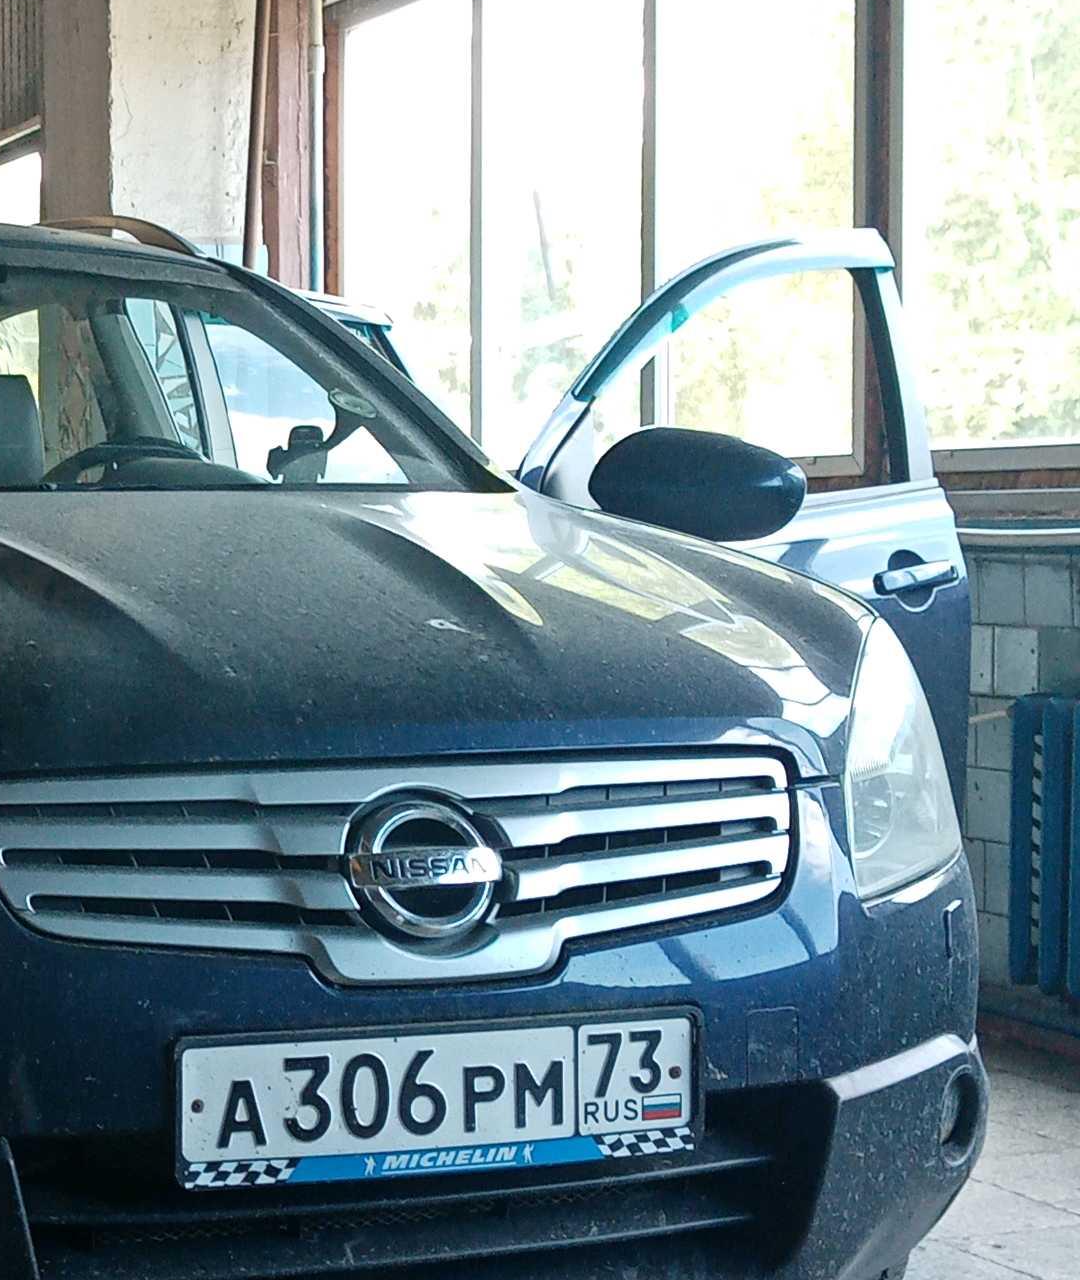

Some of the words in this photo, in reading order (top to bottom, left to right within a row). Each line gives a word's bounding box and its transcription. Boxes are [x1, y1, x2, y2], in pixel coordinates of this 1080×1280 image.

[369, 854, 488, 881] NISSAN
[585, 1029, 663, 1099] 73
[584, 1097, 639, 1124] RUS
[381, 1145, 518, 1171] MICHELIN
